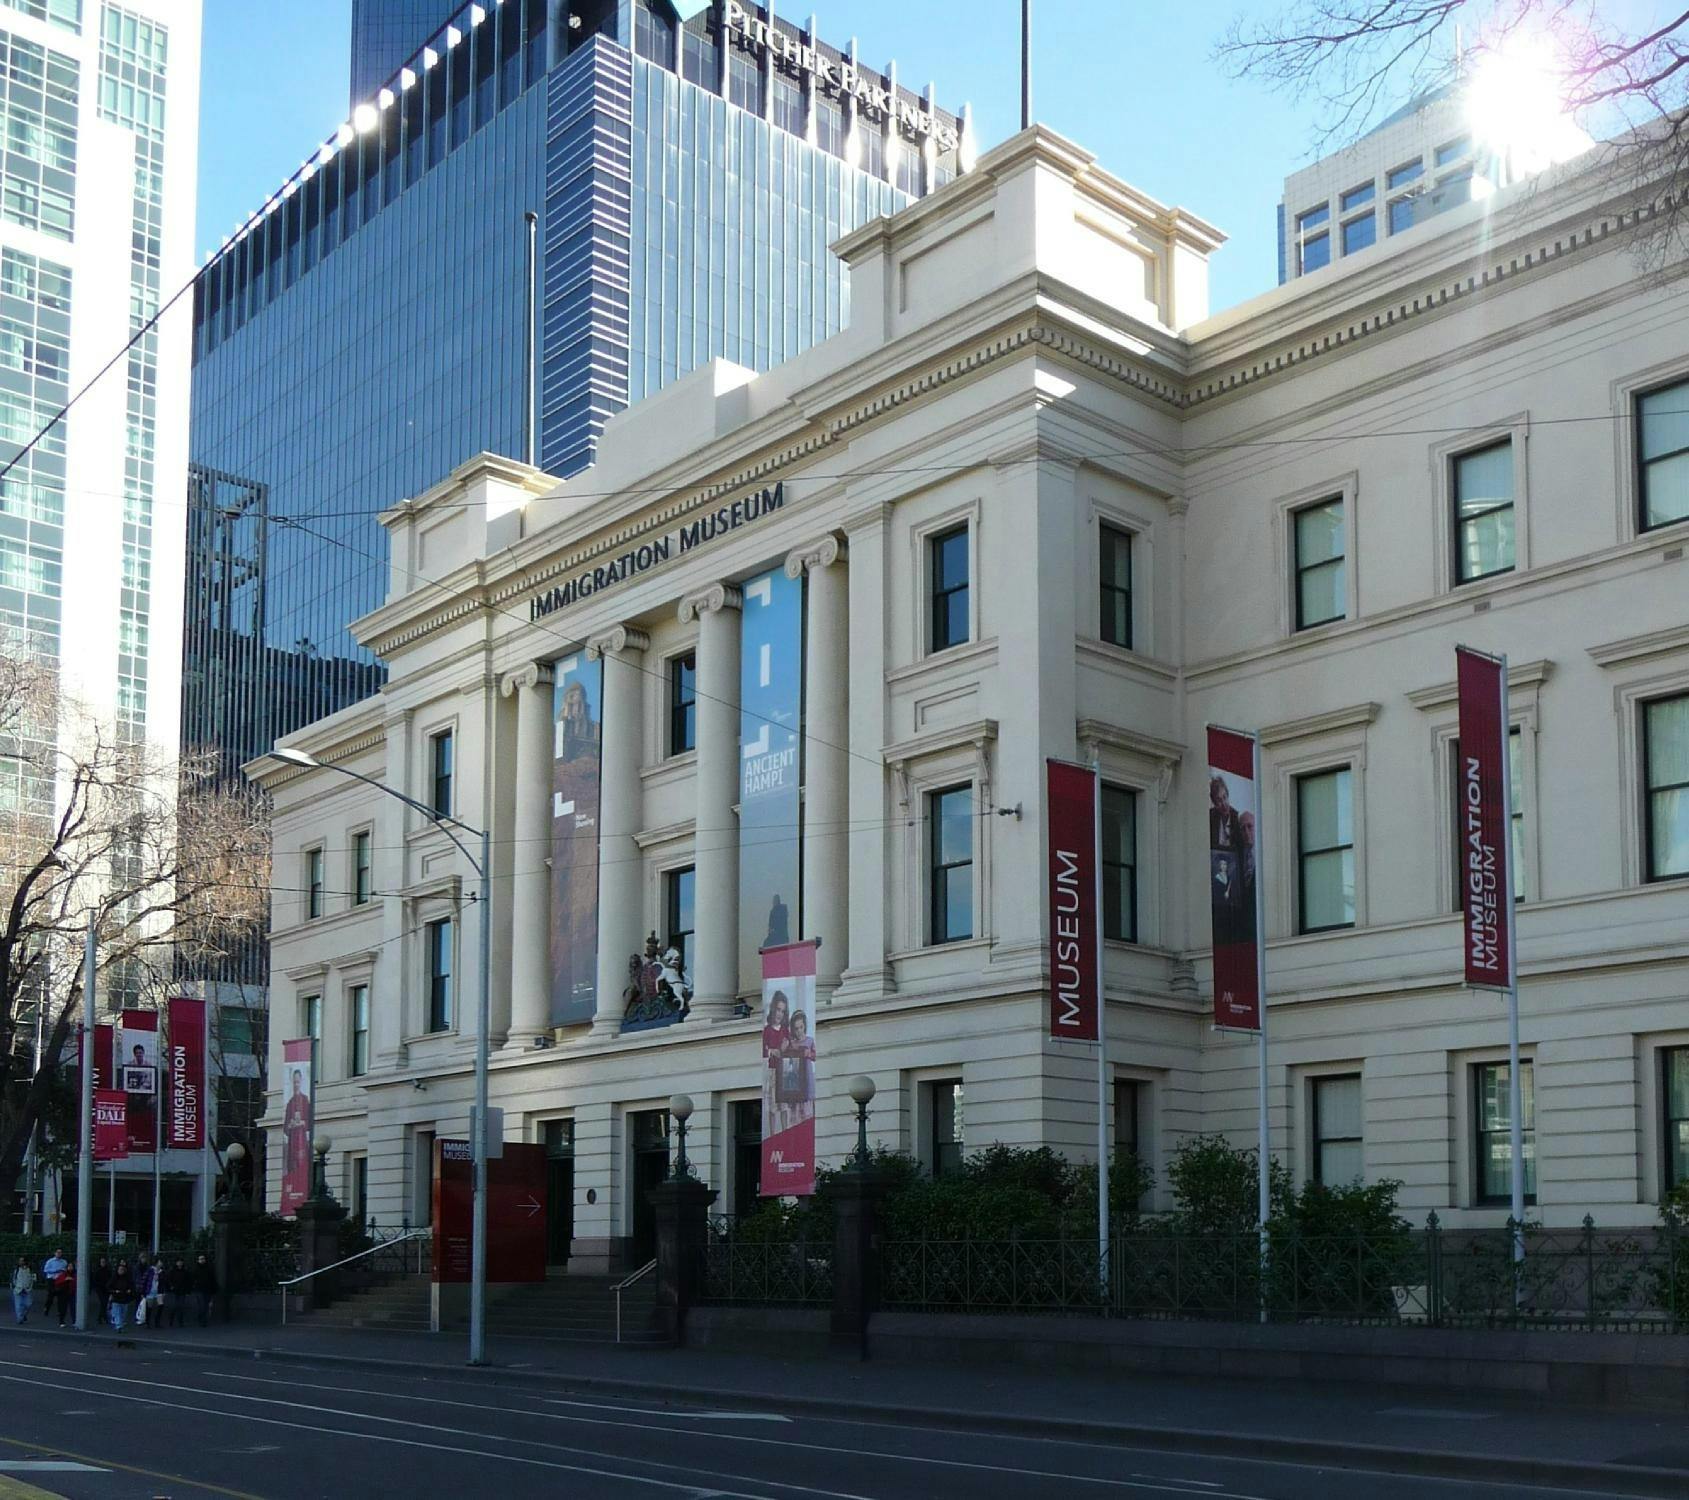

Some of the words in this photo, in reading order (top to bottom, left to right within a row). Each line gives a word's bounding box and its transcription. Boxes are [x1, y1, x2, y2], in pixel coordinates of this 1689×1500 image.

[726, 1, 840, 87] PITCHER
[530, 536, 669, 621] IMMIGRATION
[680, 481, 784, 552] MUSEUM
[745, 747, 796, 777] ANCIENT
[745, 768, 783, 795] HAMPI
[1467, 757, 1485, 968] IMMIGRATION
[1484, 845, 1499, 970] MUSEUM
[1056, 849, 1081, 1026] MUSEUM
[174, 1046, 186, 1142] IMMIGRATION
[185, 1084, 197, 1142] MUSEUM
